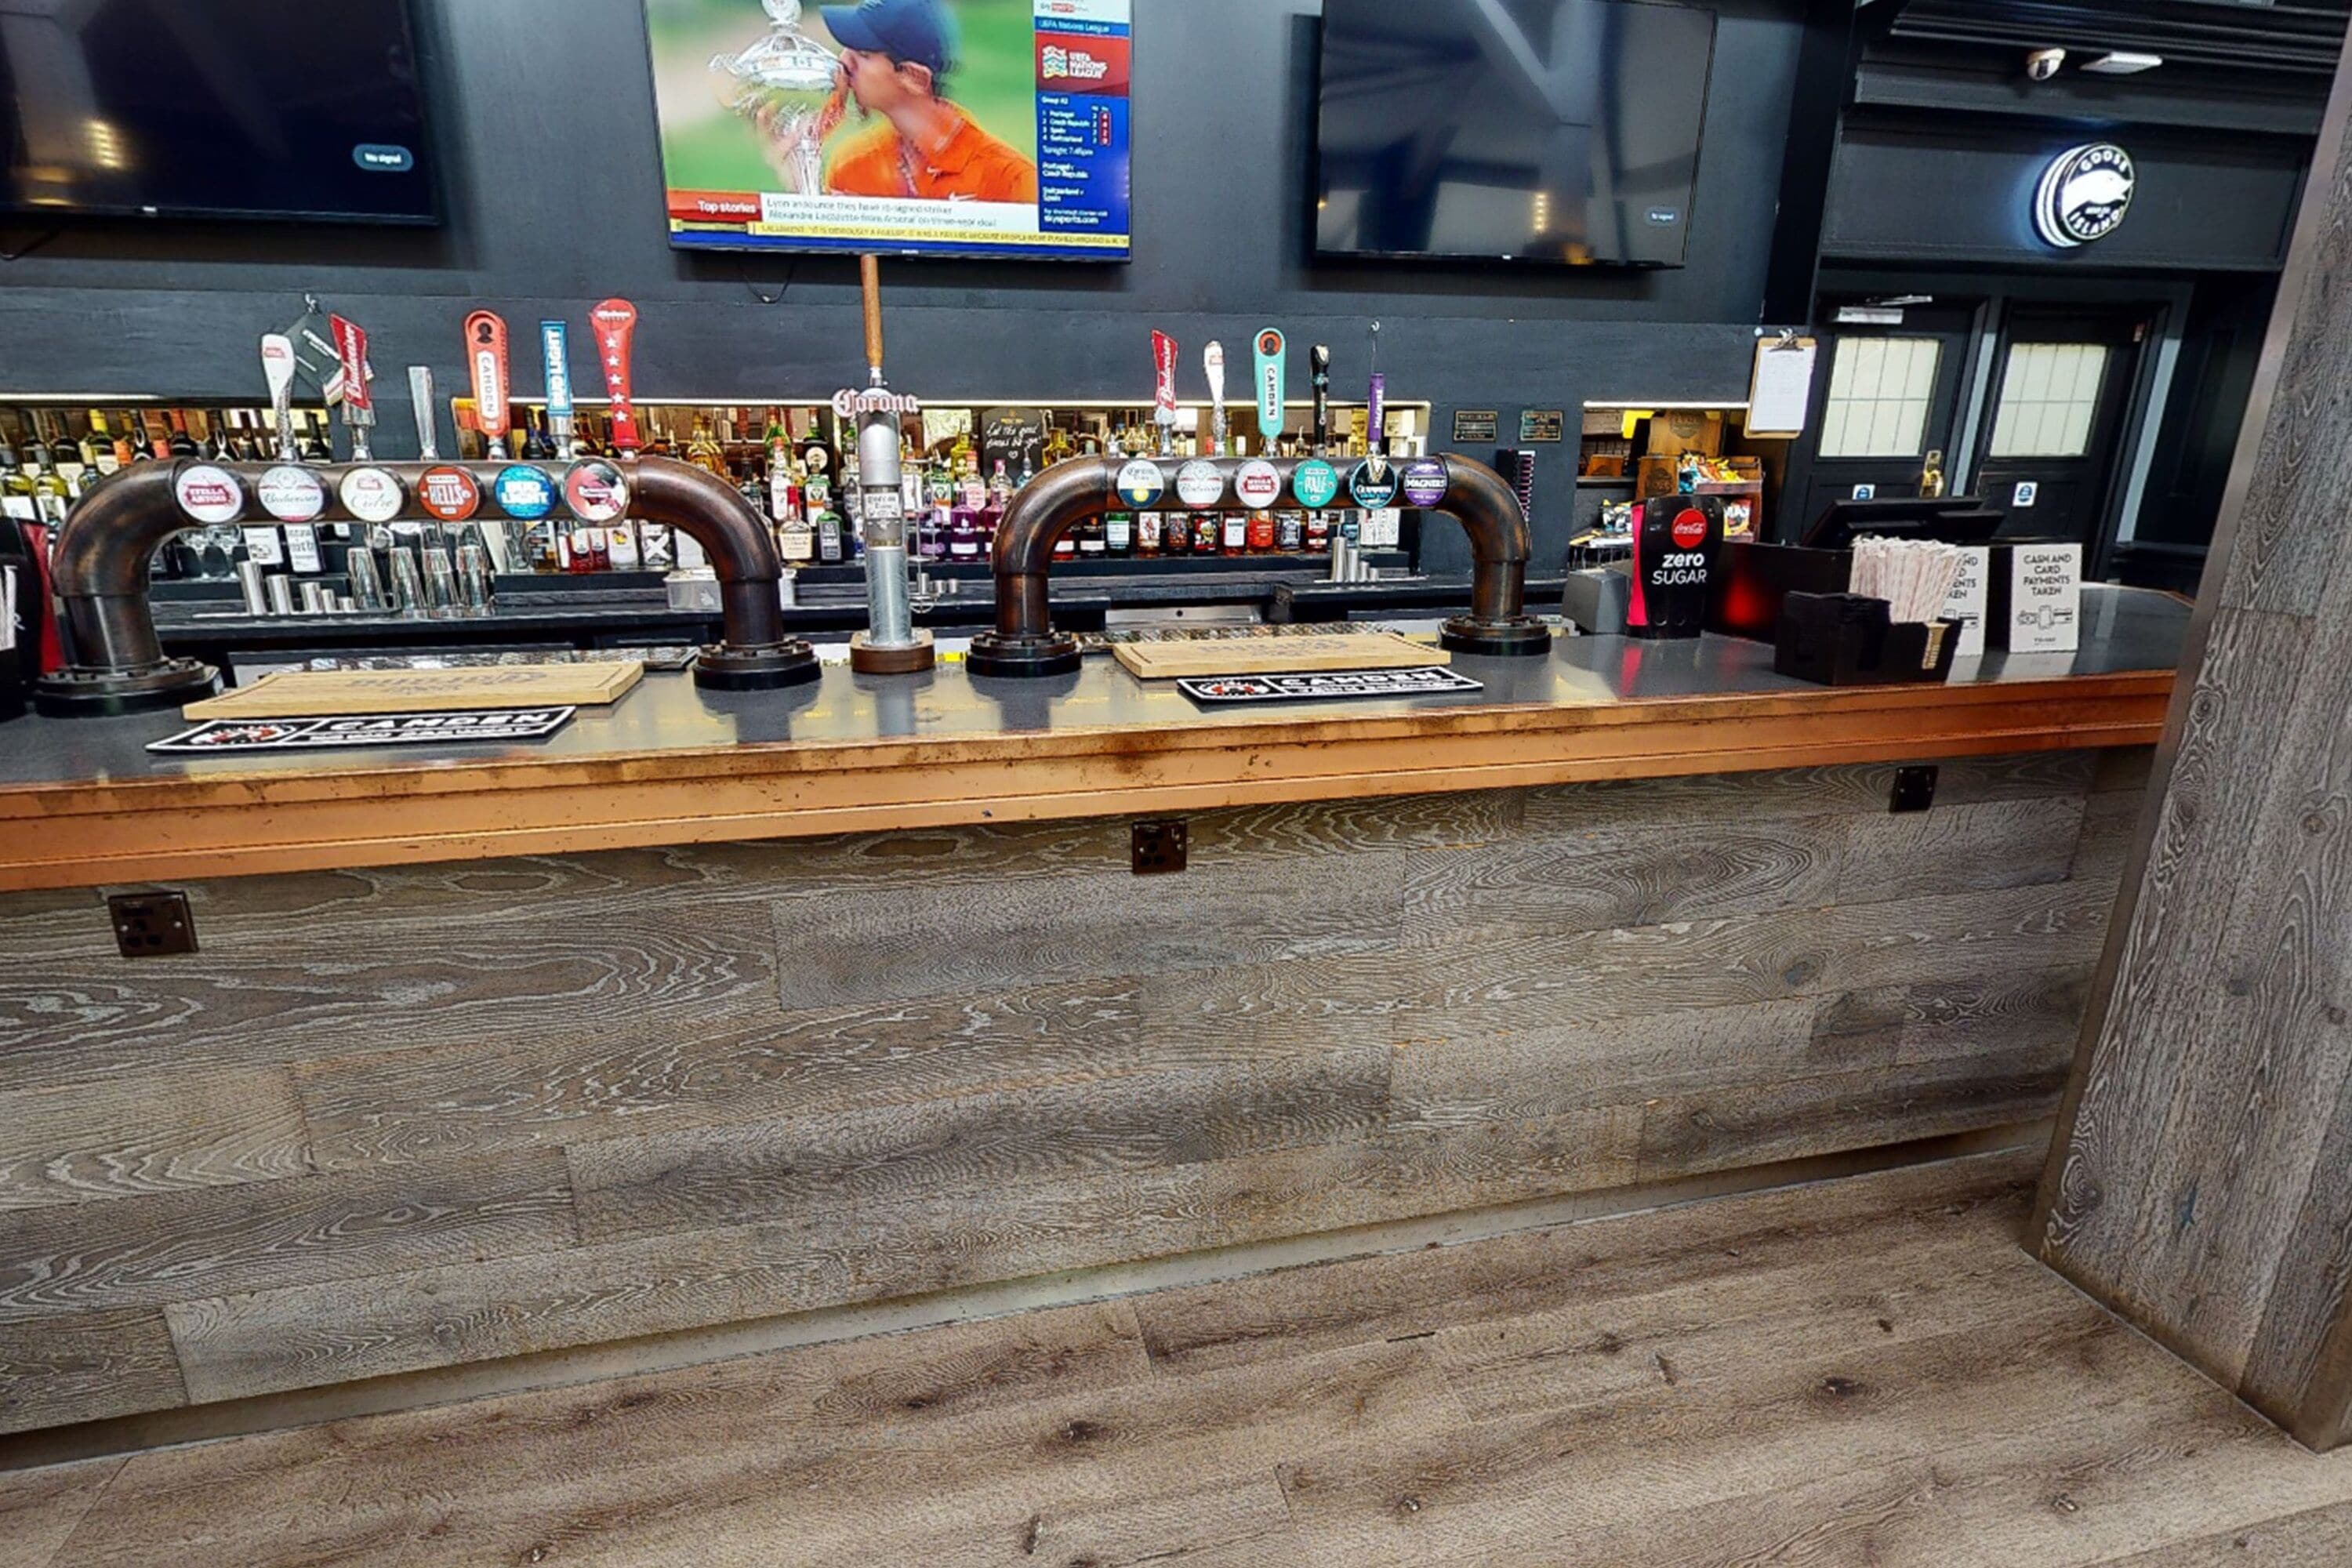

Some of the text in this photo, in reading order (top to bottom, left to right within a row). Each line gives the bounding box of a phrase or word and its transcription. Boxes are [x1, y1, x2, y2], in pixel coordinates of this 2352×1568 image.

[1085, 24, 1110, 34] League
[379, 153, 401, 165] signal
[2080, 150, 2129, 172] GOOSE
[698, 200, 757, 213] Top stories
[767, 199, 790, 209] Lyon
[793, 201, 835, 209] announce
[769, 212, 814, 220] Alexandre
[2069, 207, 2121, 235] ISLAND
[341, 324, 364, 401] Budweiser
[1158, 338, 1174, 404] Budweiser
[481, 356, 495, 413] CAMDEN
[1266, 367, 1276, 417] CAMDEN
[832, 388, 920, 419] Corona
[1304, 477, 1327, 494] PALE
[1406, 478, 1446, 488] MAGNERS
[263, 492, 318, 504] Budweiser
[428, 485, 465, 506] HELLS
[1662, 553, 1705, 568] zero
[2024, 553, 2073, 564] CASH AND
[1652, 568, 1708, 585] SUGAR
[2034, 565, 2061, 575] CARD
[2024, 575, 2071, 586] PAYMENTS
[1947, 590, 1968, 599] KEN
[2032, 587, 2063, 596] TAKEN
[1280, 672, 1442, 687] CAMDEN
[330, 713, 549, 731] CAMDEN
